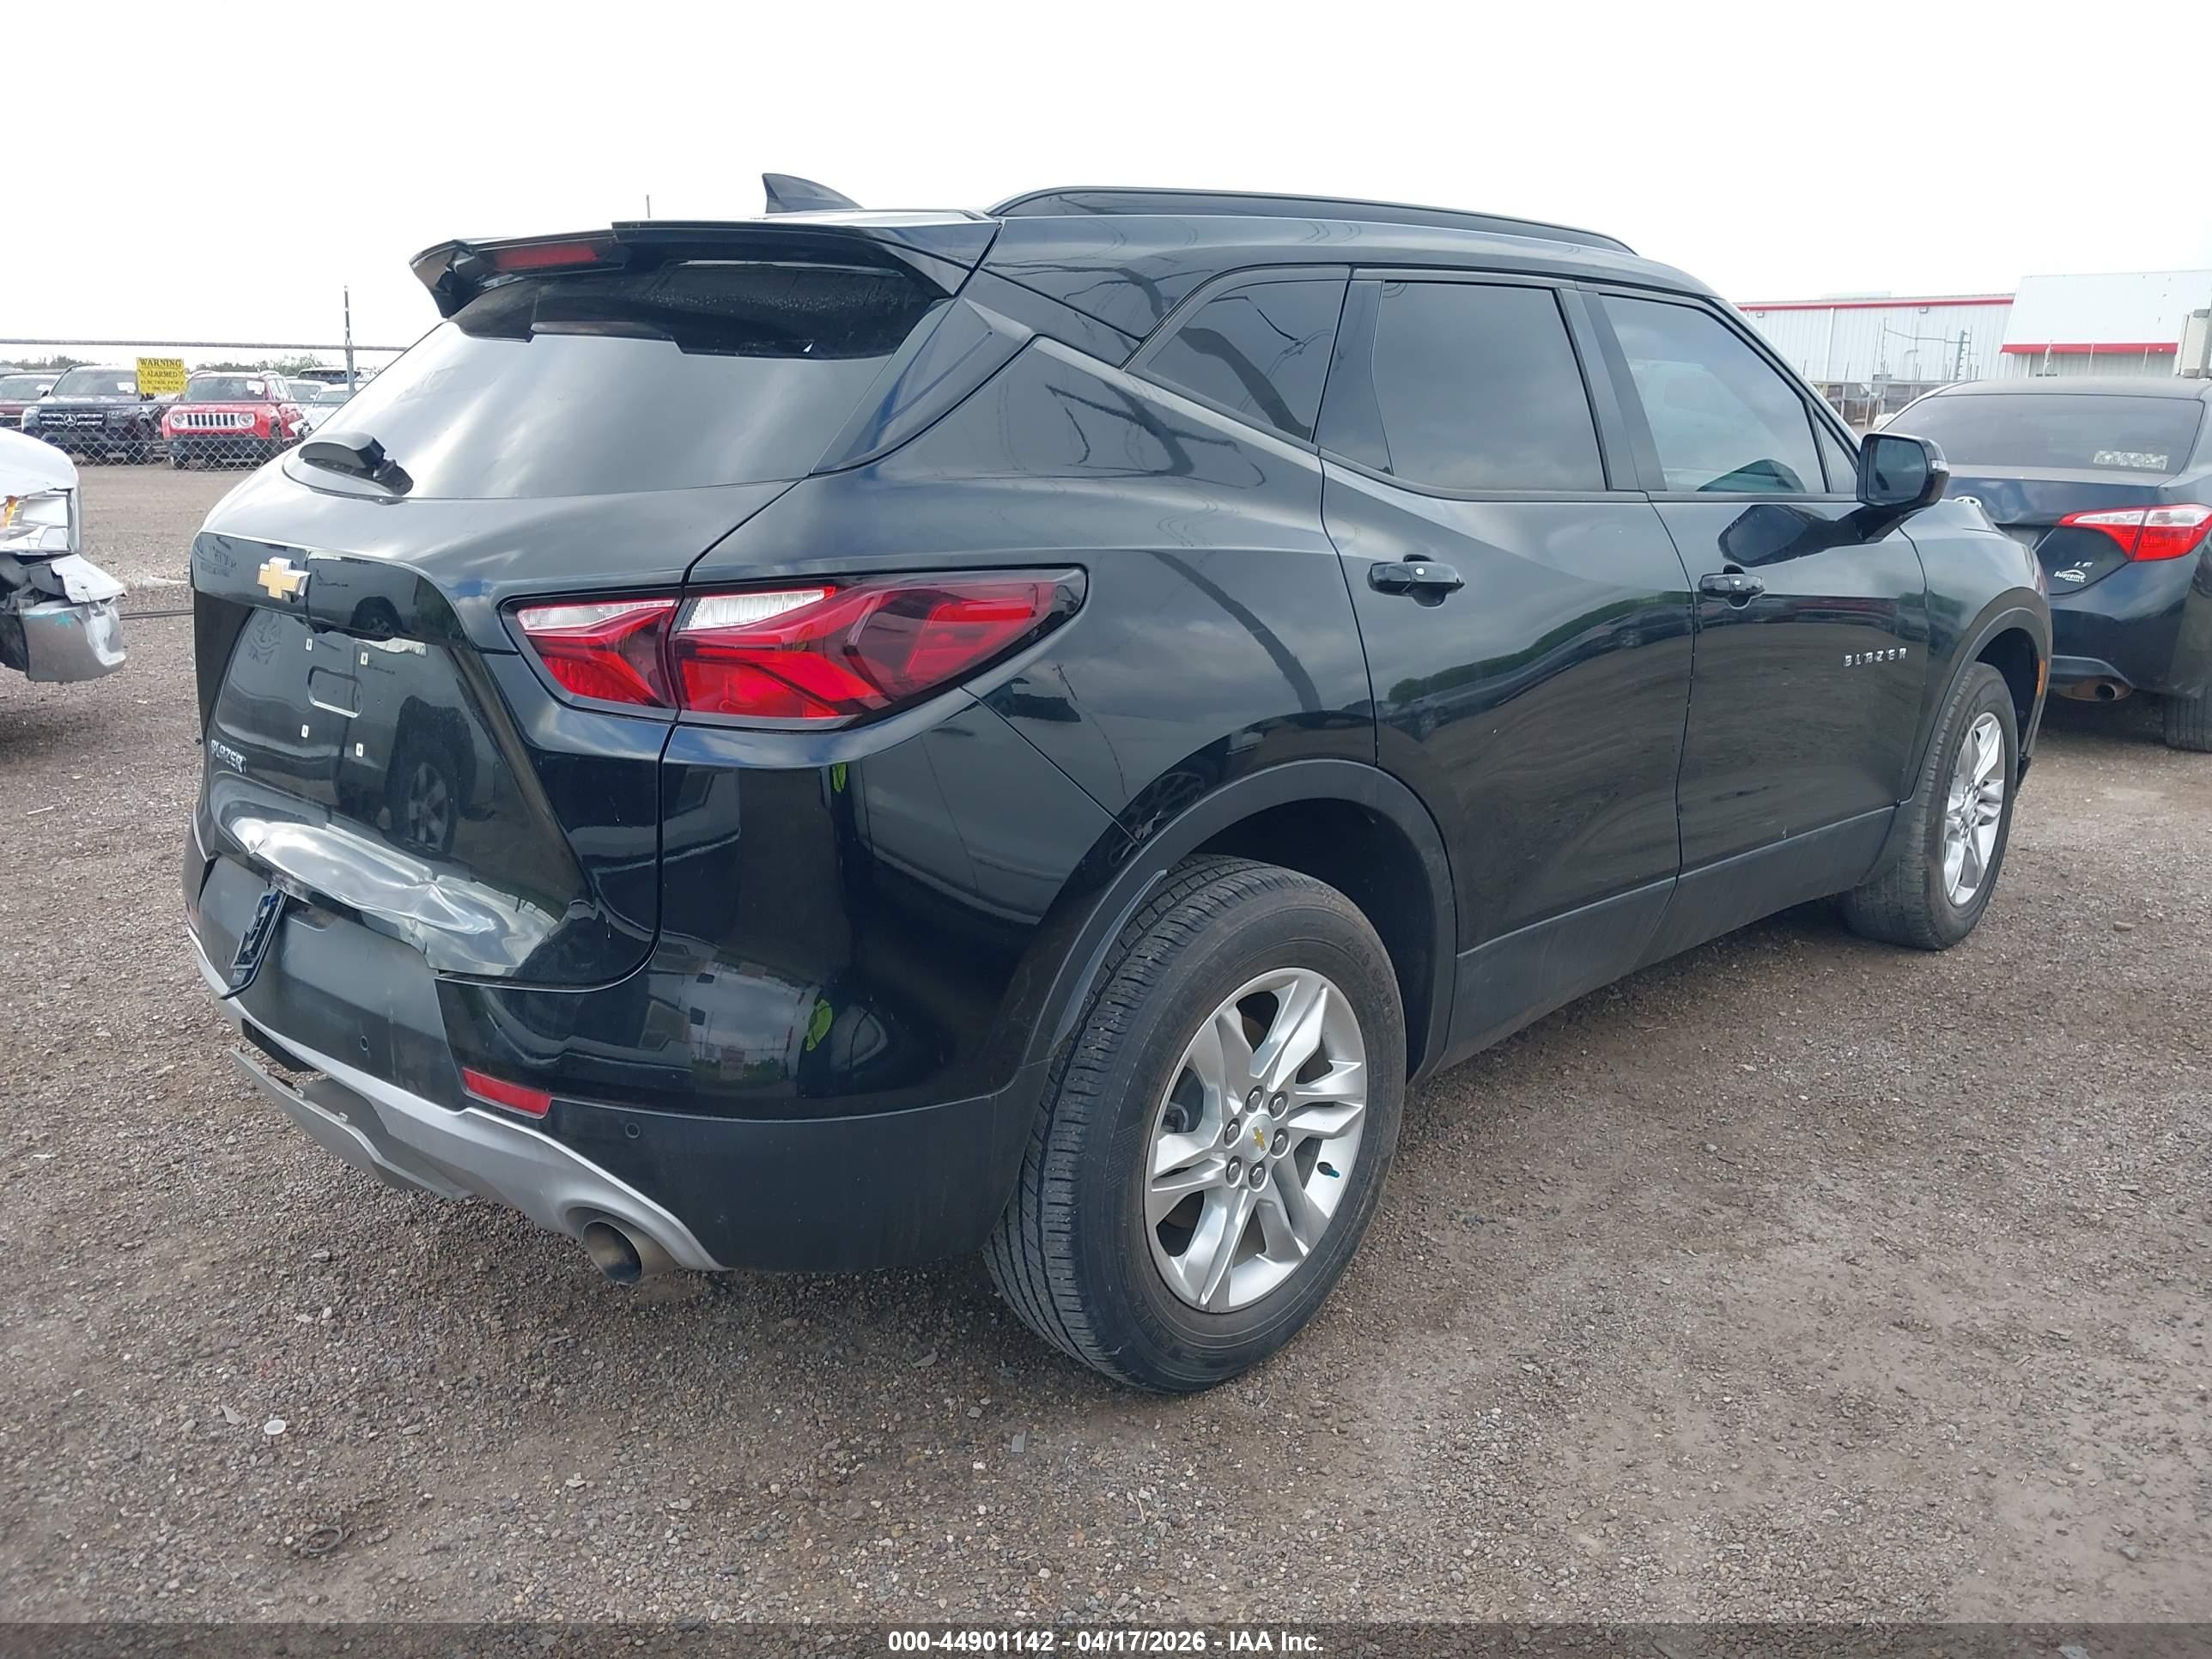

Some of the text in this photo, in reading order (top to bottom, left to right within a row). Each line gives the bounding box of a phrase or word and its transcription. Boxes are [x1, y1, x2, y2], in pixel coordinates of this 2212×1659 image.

[140, 358, 182, 368] WARNING
[1844, 647, 1907, 666] BLAZER
[211, 739, 247, 773] BLAZER
